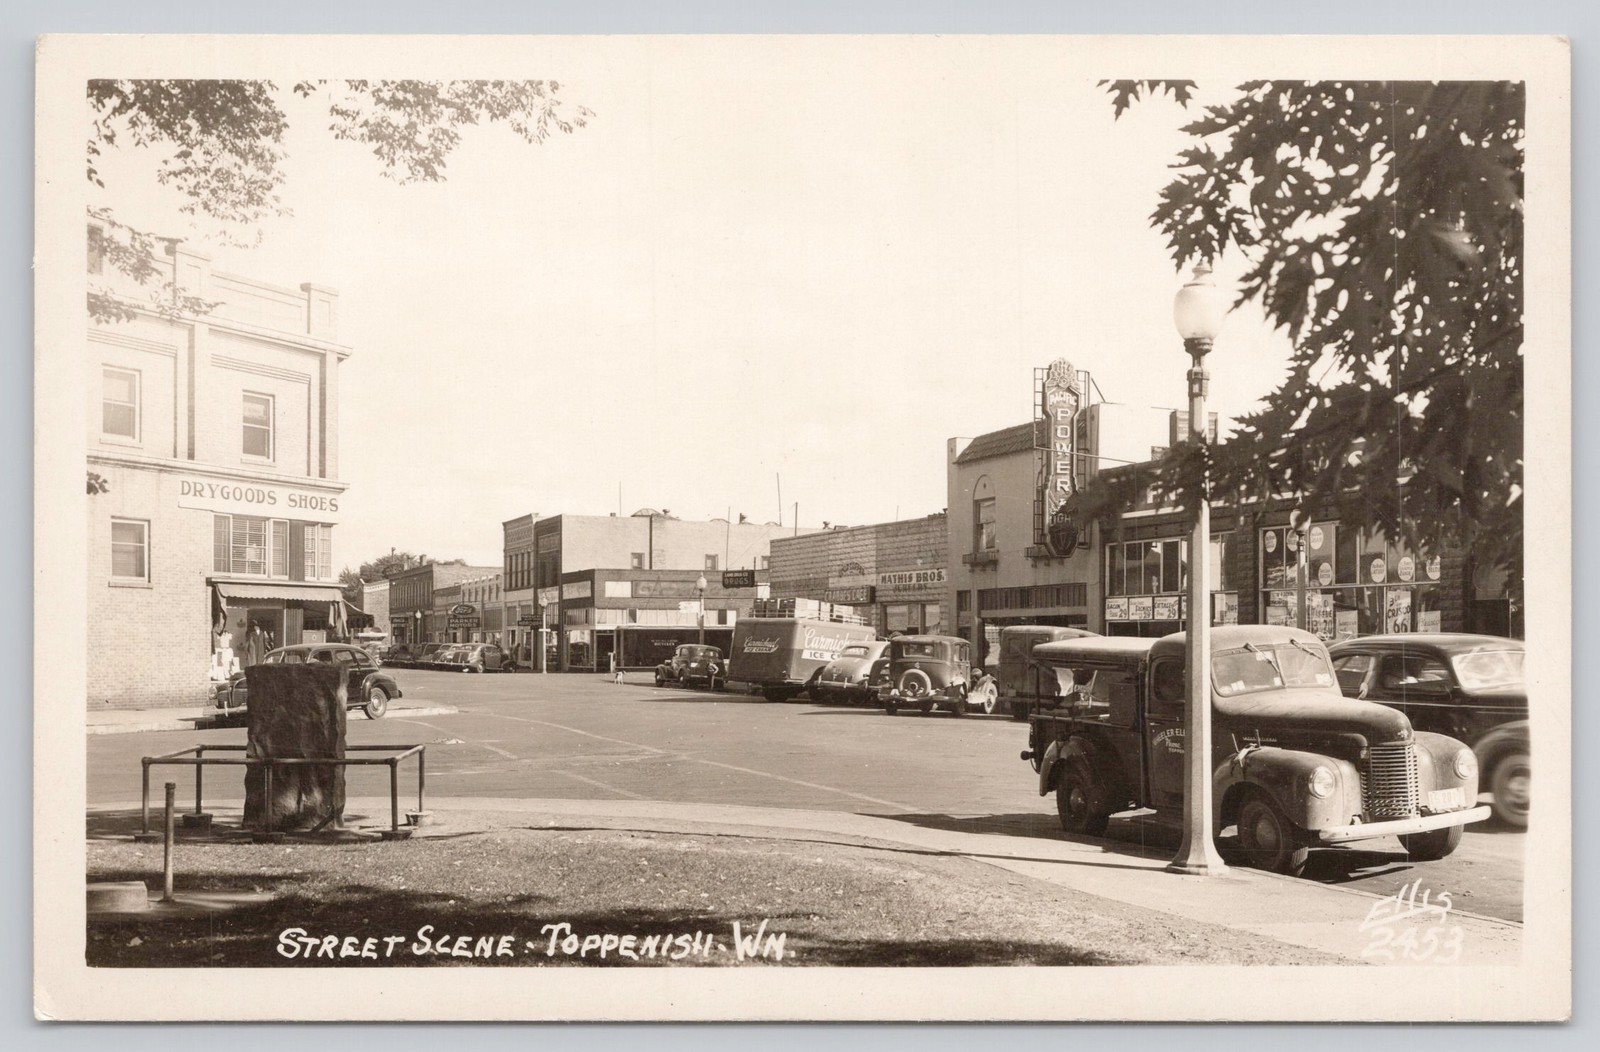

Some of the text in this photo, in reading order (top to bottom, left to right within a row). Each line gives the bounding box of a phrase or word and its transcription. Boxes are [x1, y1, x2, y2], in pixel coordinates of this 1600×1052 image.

[1056, 408, 1072, 492] POWER
[180, 480, 339, 513] DRYGOODS SHOES
[724, 577, 749, 585] DRUGS
[881, 570, 945, 585] MATHIS BROS.
[1167, 608, 1177, 618] 29
[1387, 605, 1411, 619] CRISCO
[1393, 618, 1408, 633] 66
[804, 626, 869, 651] Carmich
[809, 651, 825, 659] ICE
